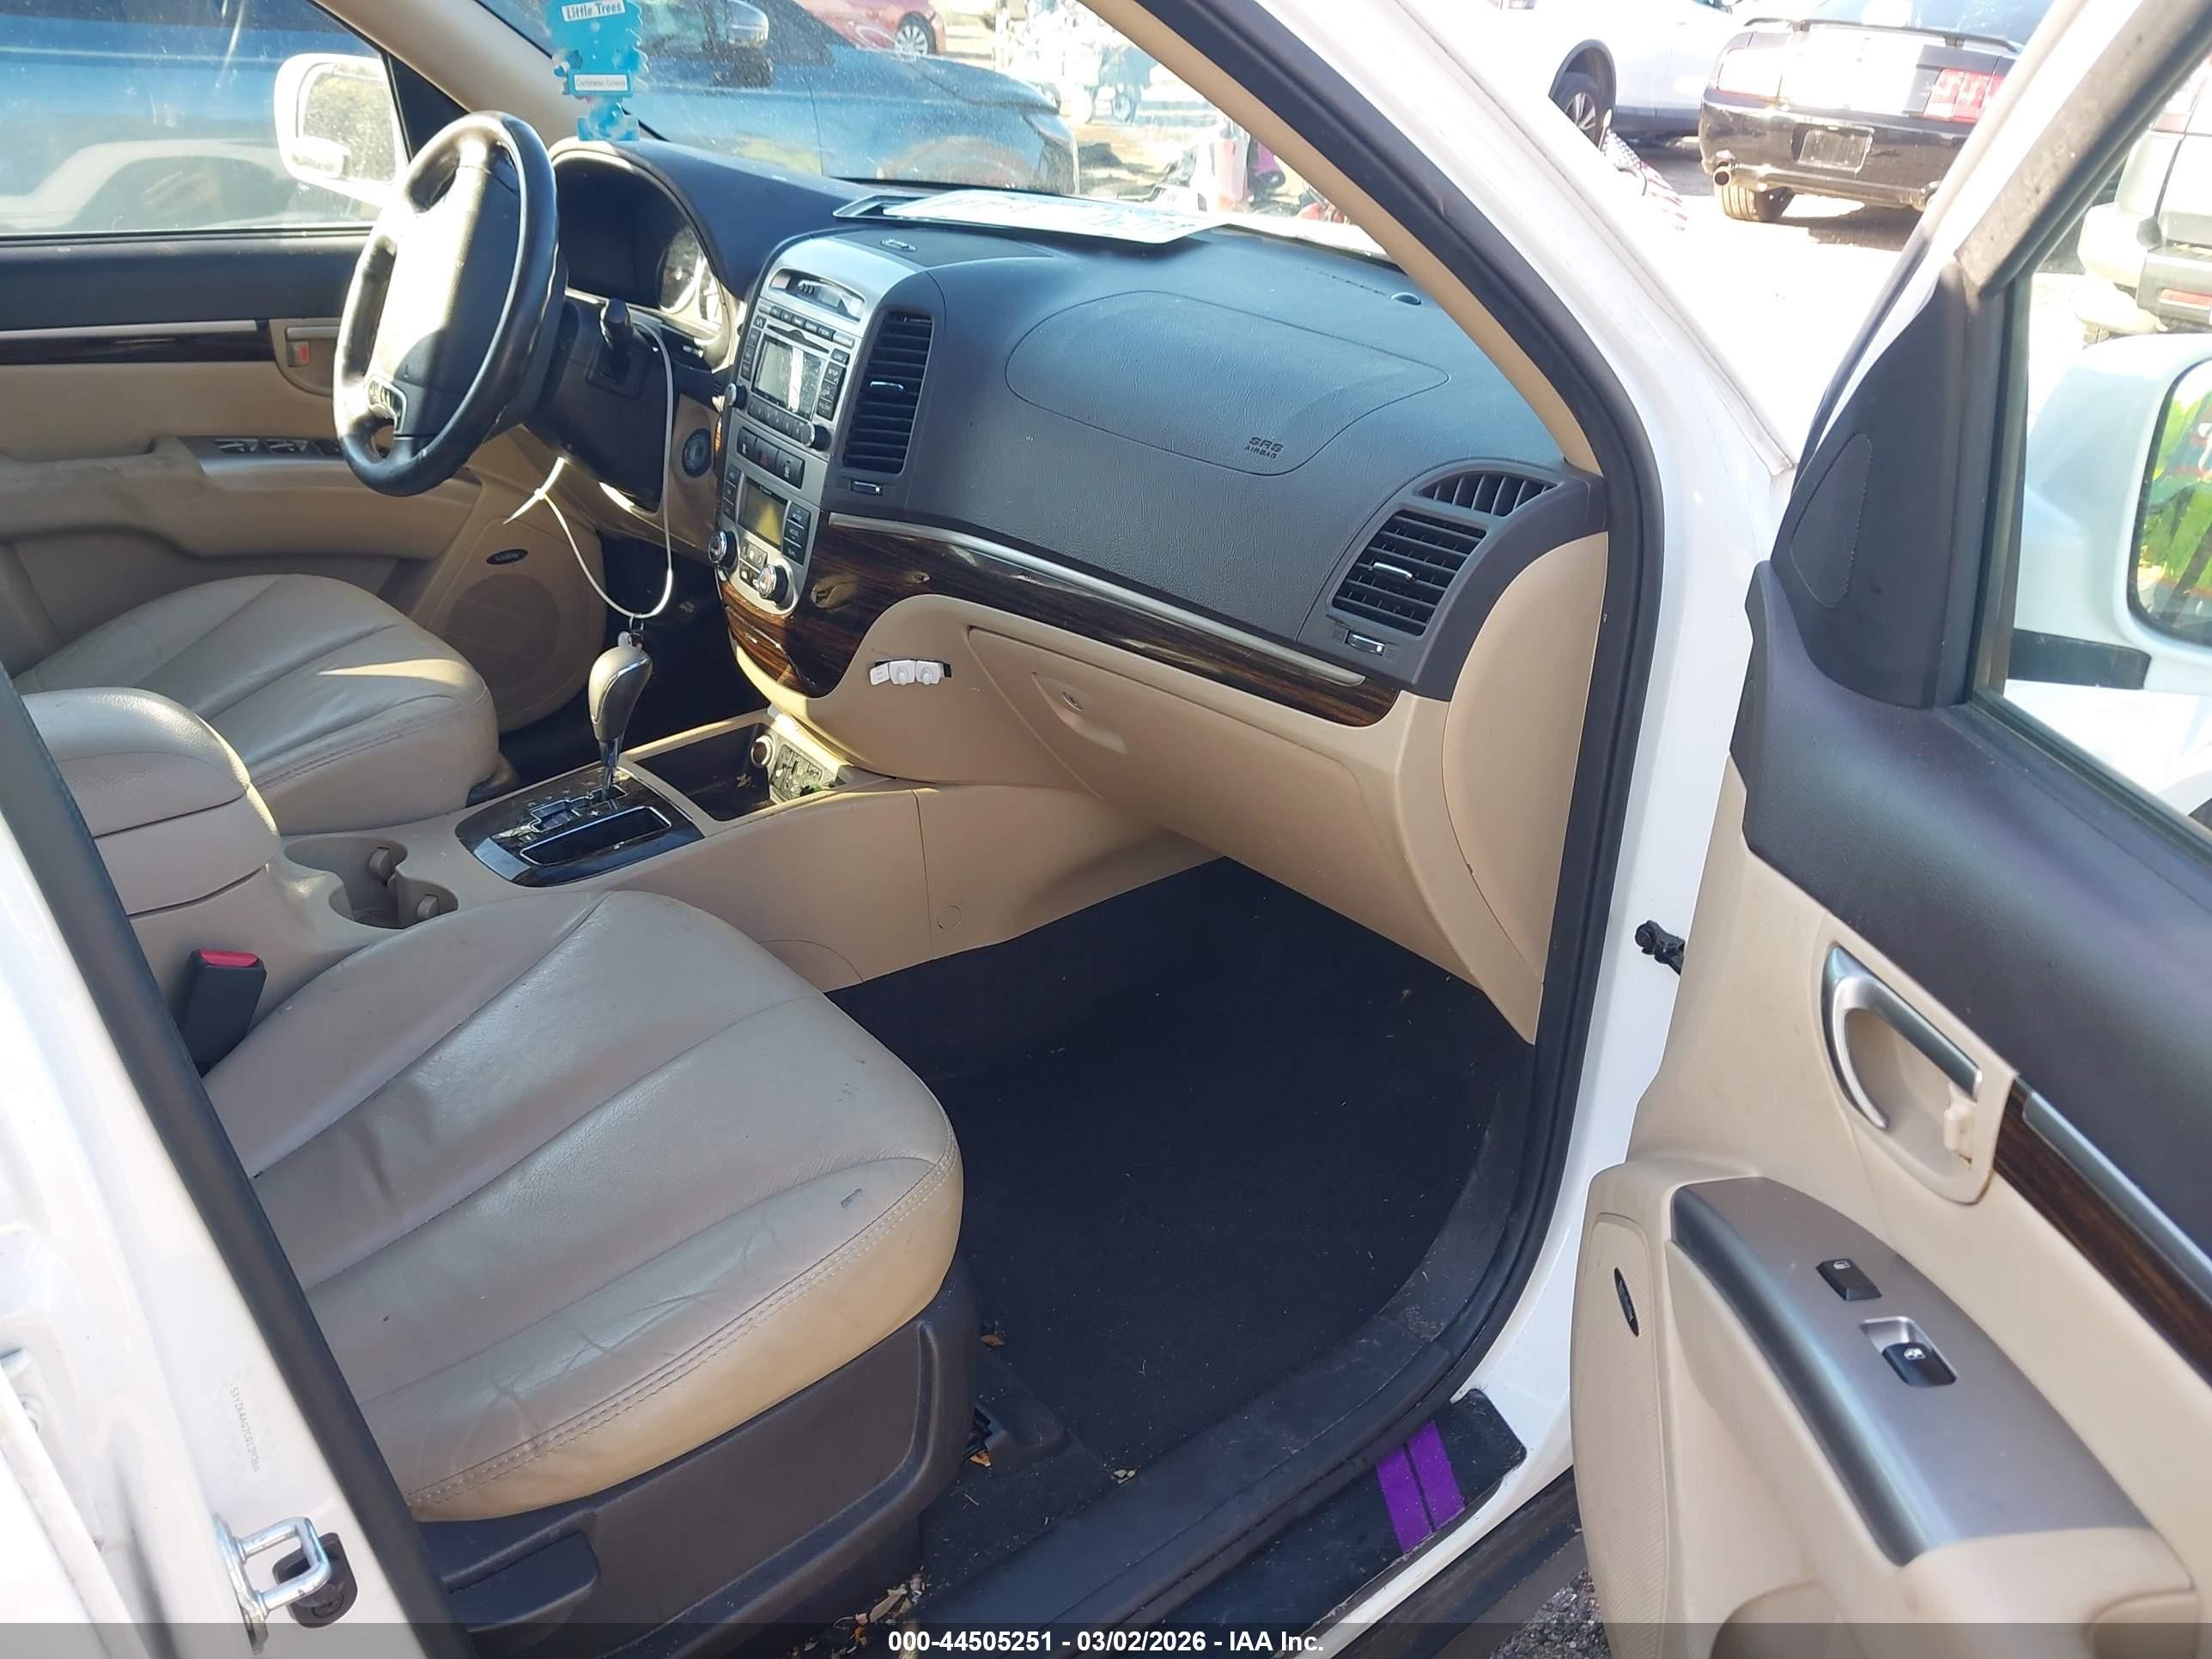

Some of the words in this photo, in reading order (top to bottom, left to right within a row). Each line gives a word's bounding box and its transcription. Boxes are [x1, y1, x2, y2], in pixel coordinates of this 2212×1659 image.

[567, 5, 592, 20] Little
[595, 3, 622, 15] Trees
[1243, 444, 1278, 459] AIRBAG
[1249, 436, 1284, 453] SRS
